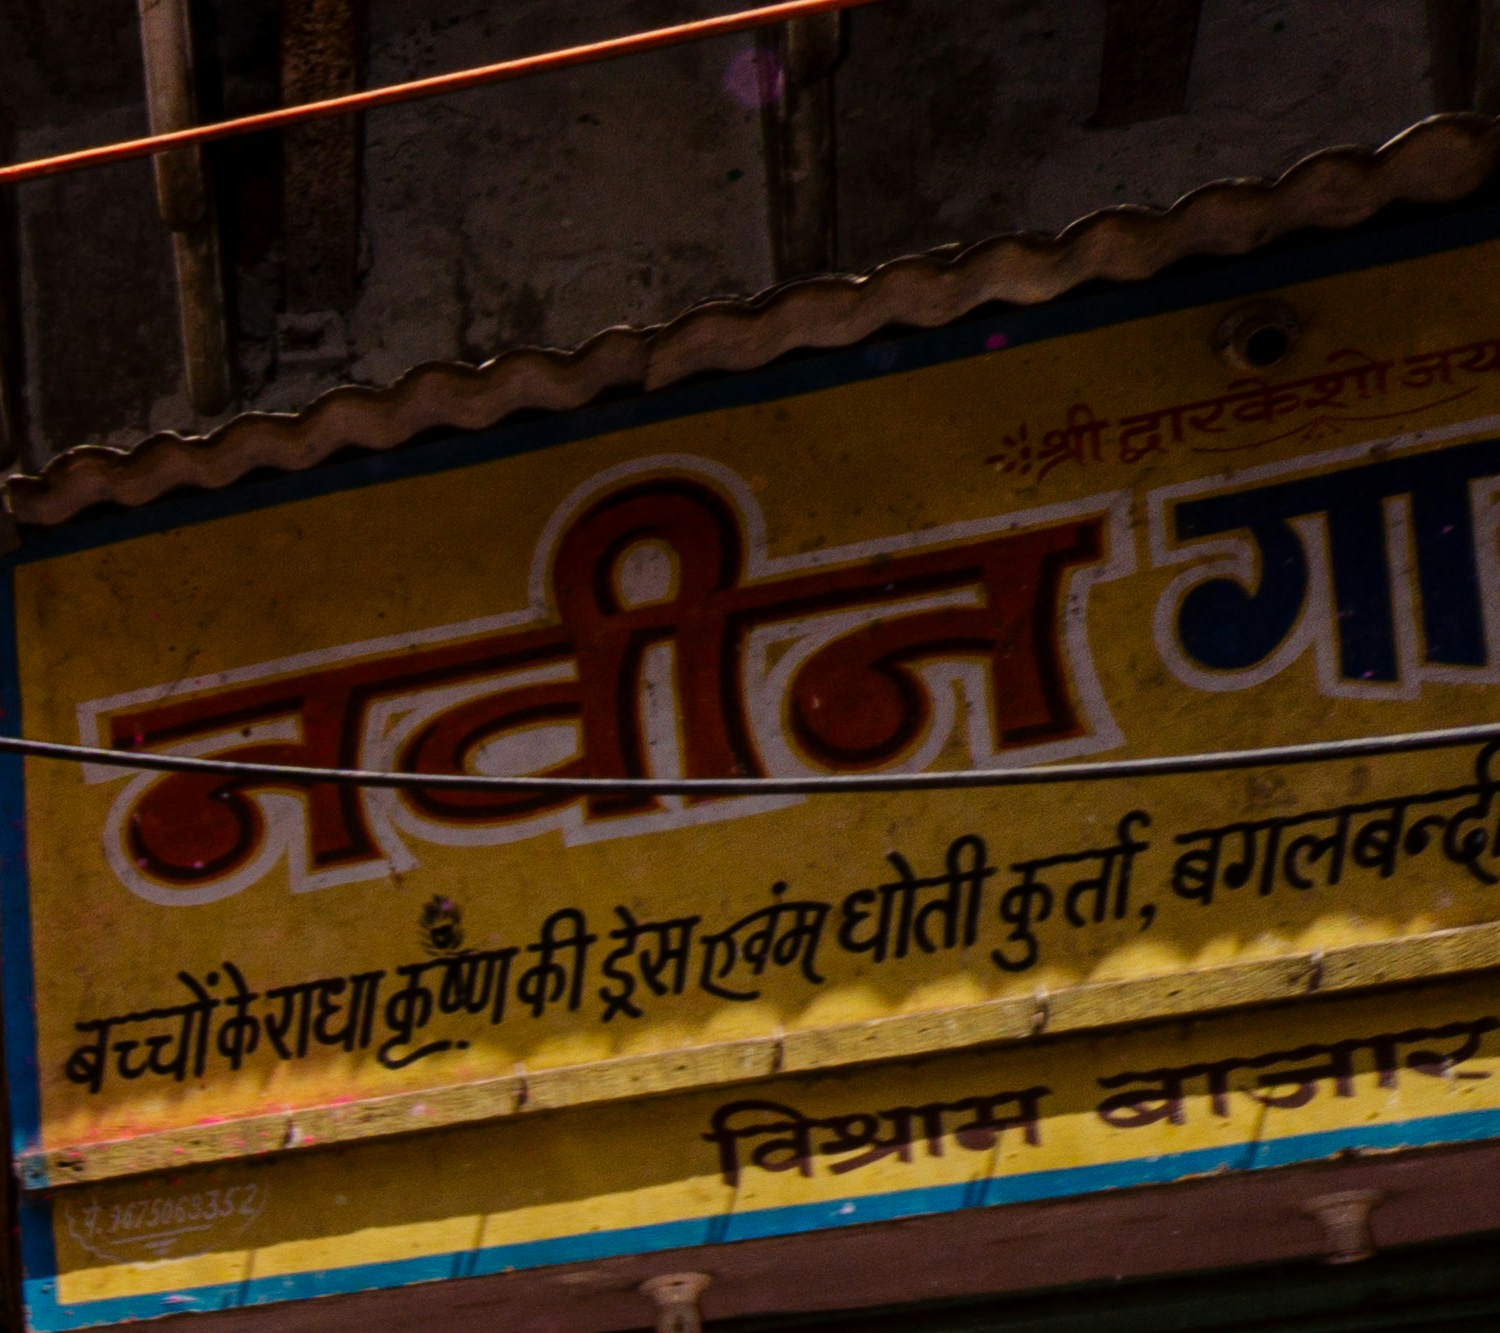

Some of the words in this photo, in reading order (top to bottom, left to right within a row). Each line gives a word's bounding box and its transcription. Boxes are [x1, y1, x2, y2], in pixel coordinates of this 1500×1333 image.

[95, 466, 1115, 890] नवीन
[838, 837, 996, 963] धोती
[704, 1086, 1055, 1187] विश्राम
[1097, 1015, 1500, 1128] बाजार
